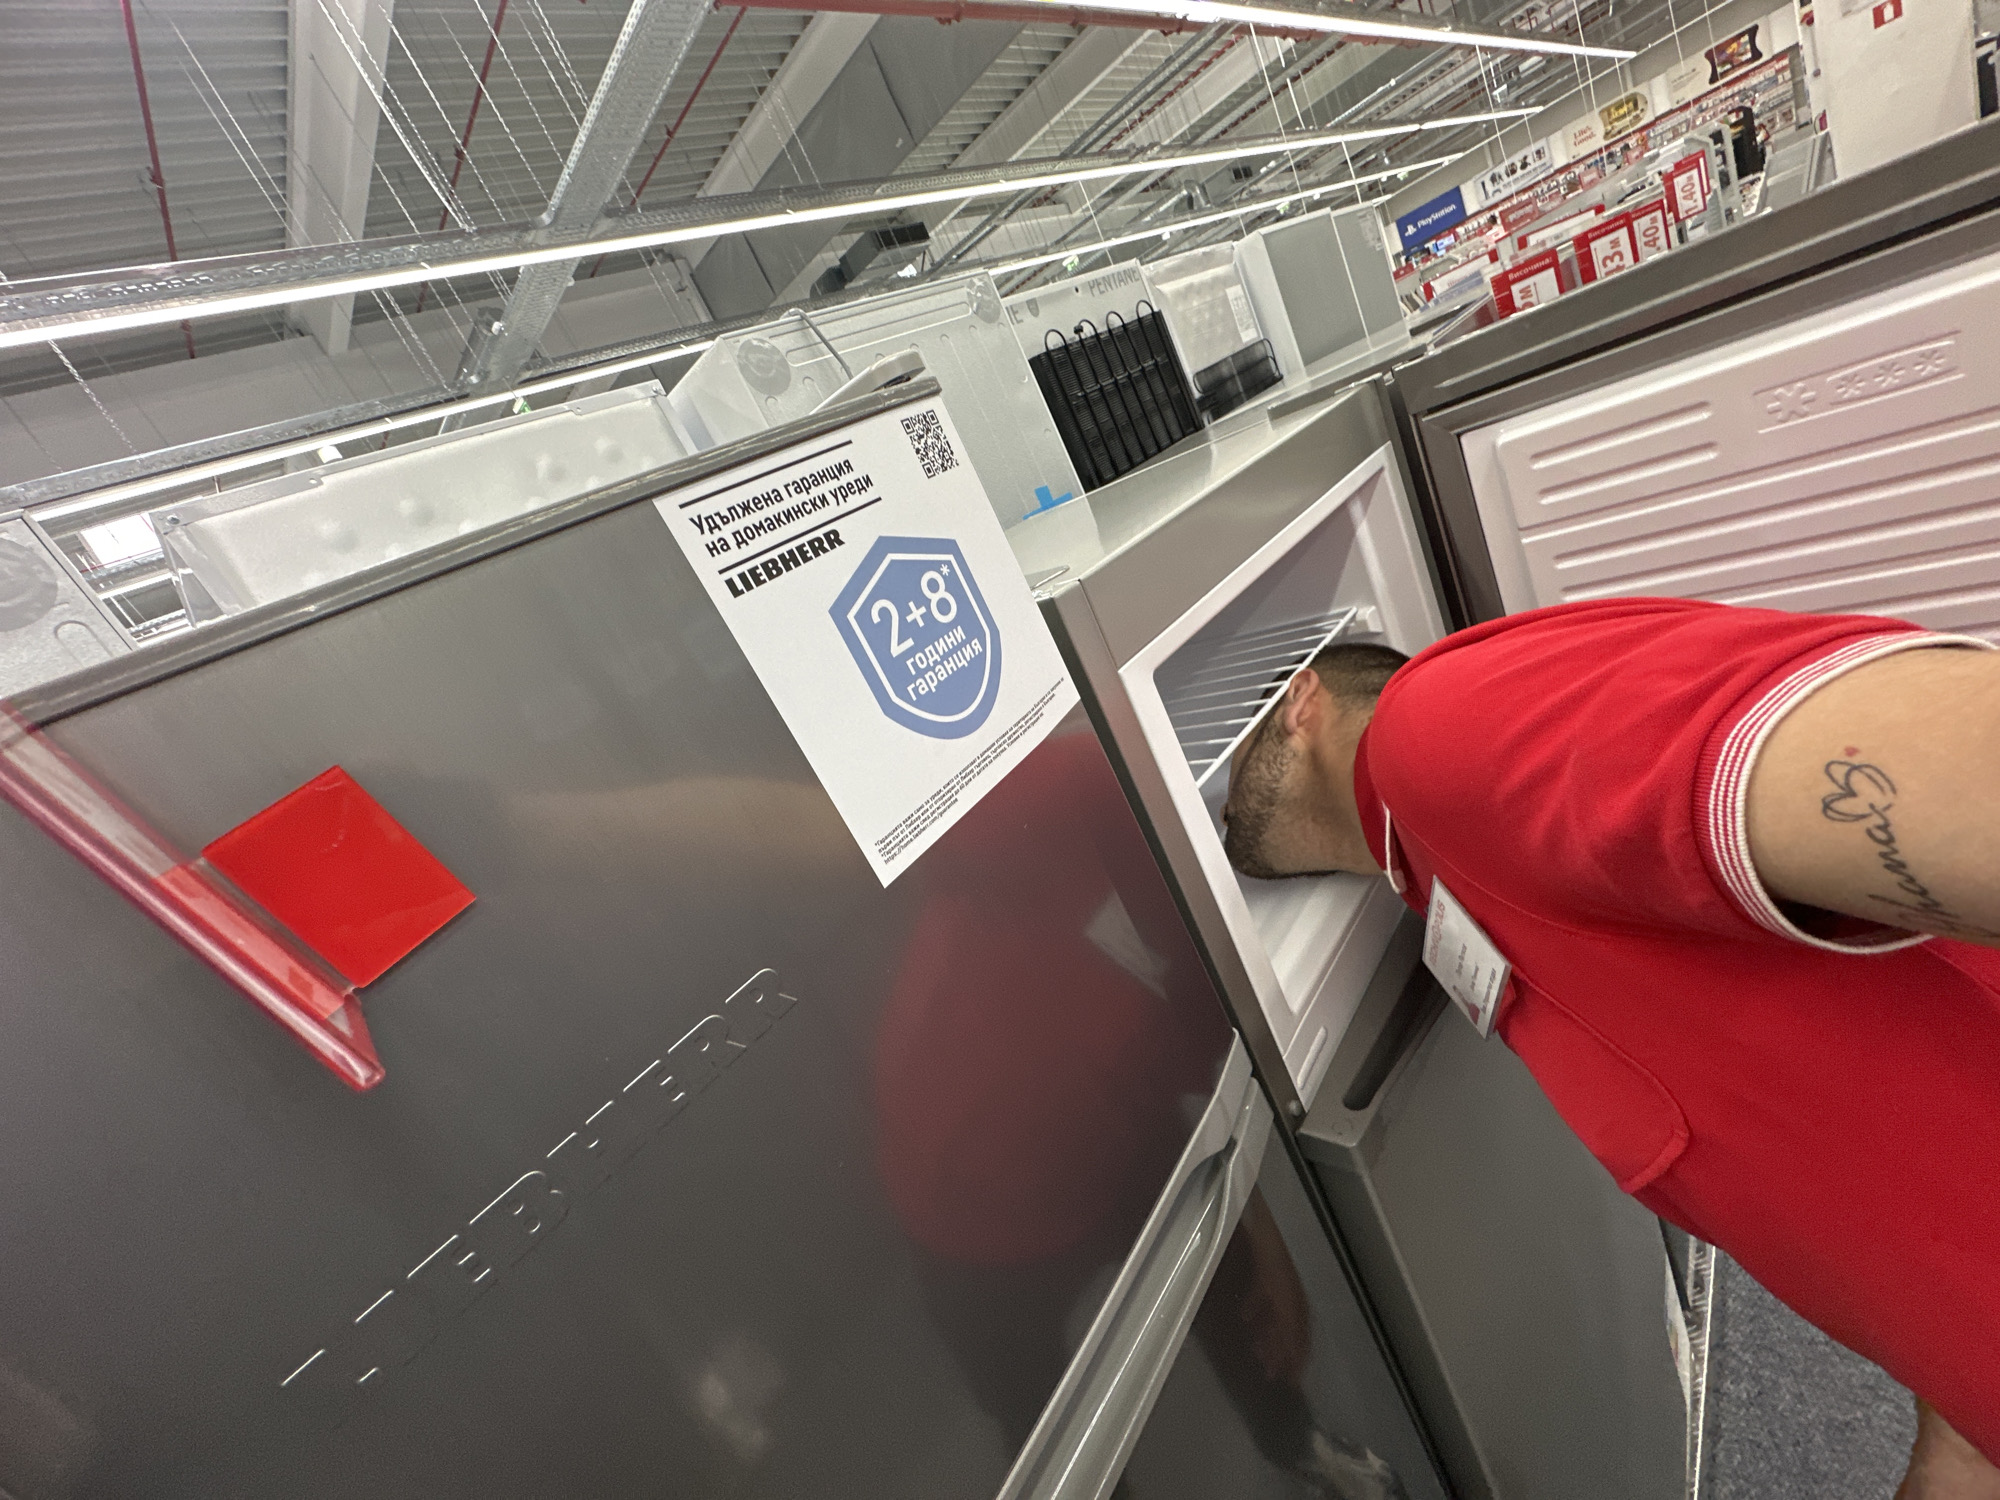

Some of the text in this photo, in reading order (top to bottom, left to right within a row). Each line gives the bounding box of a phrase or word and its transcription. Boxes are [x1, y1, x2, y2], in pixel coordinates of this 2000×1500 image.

[1417, 204, 1457, 229] PlayStation
[1088, 267, 1140, 297] PENTANE
[1508, 257, 1553, 281] Височина:
[688, 459, 853, 535] Удължена гаранция
[704, 474, 873, 557] на домакински уреди
[724, 529, 845, 598] LIEBHERR
[906, 625, 965, 675] години
[906, 638, 982, 700] гаранция
[280, 967, 799, 1428] LIEBHERR
